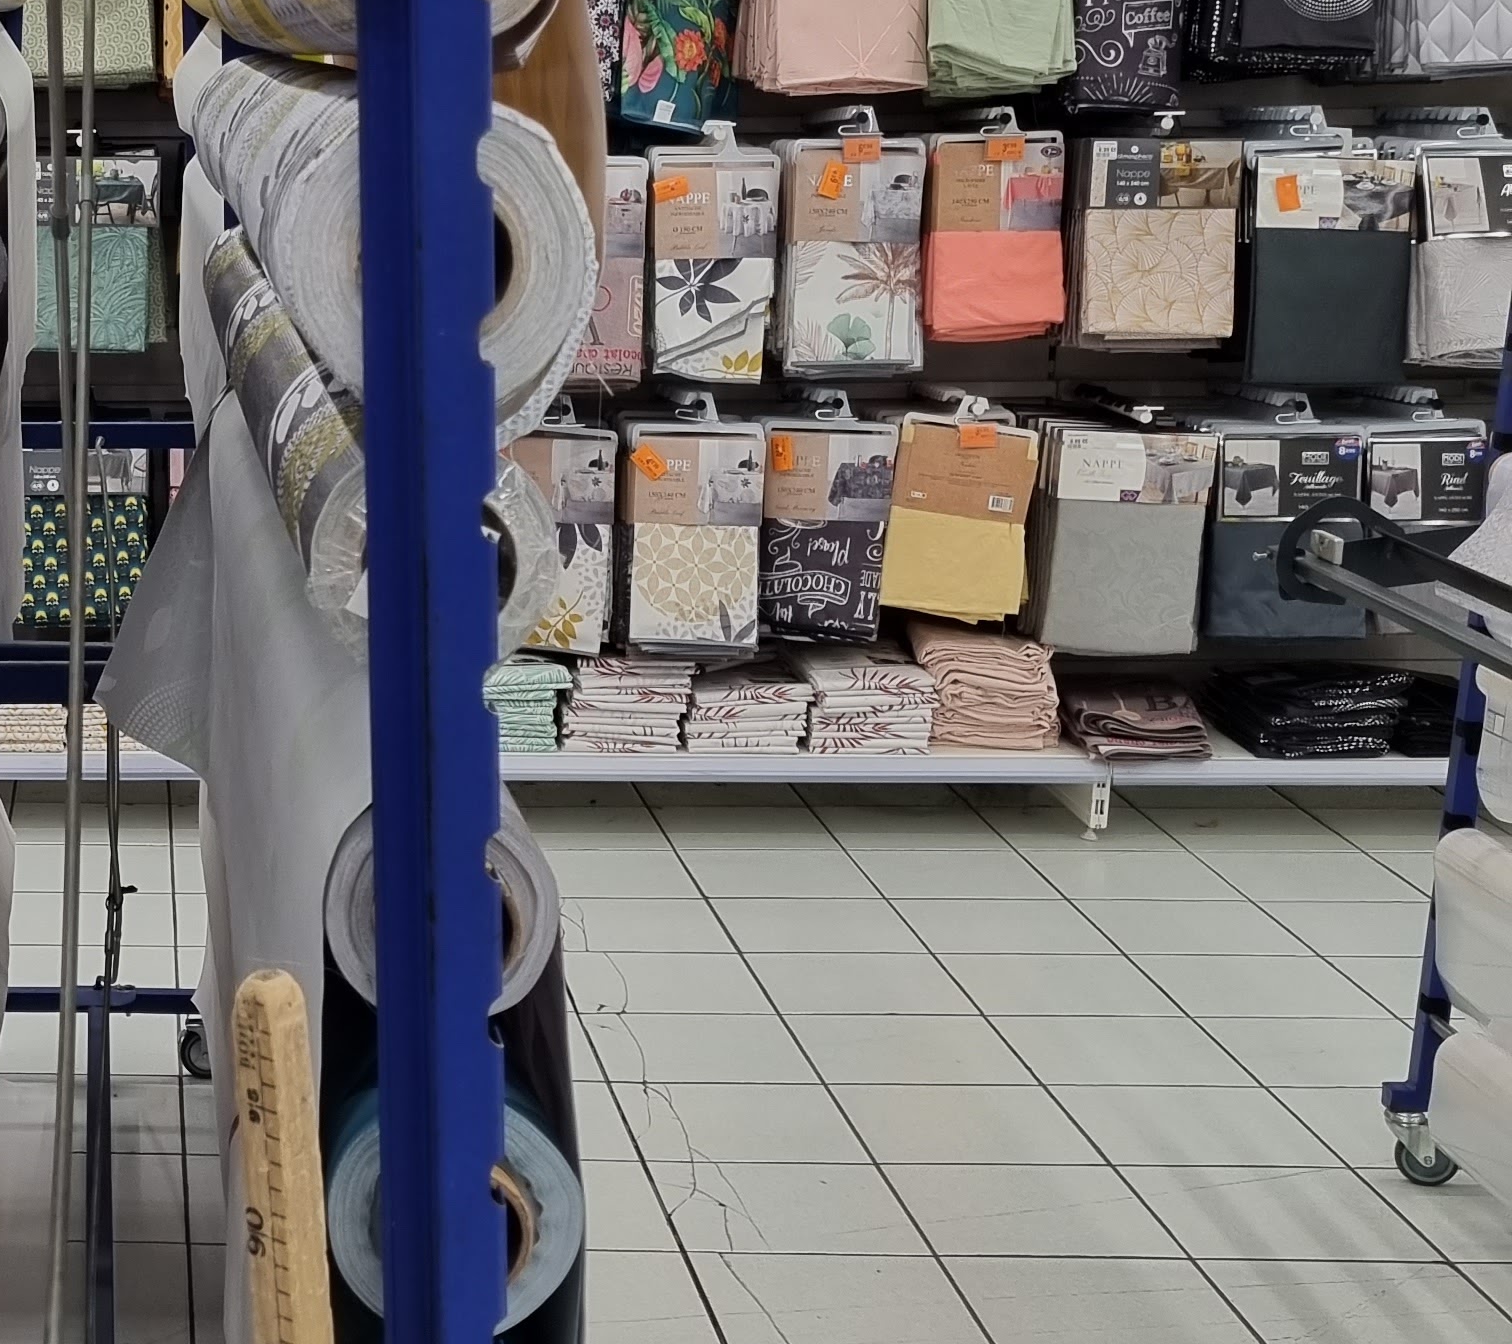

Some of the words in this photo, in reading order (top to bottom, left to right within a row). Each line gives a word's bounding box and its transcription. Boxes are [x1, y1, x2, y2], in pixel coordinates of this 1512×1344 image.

[1125, 7, 1171, 25] Coffee
[1116, 169, 1151, 179] Nappe
[29, 465, 62, 475] Nappe
[666, 459, 692, 472] PPE
[807, 537, 850, 566] Please!
[860, 570, 882, 588] ADE
[853, 590, 879, 621] LY
[245, 1206, 267, 1258] 90
